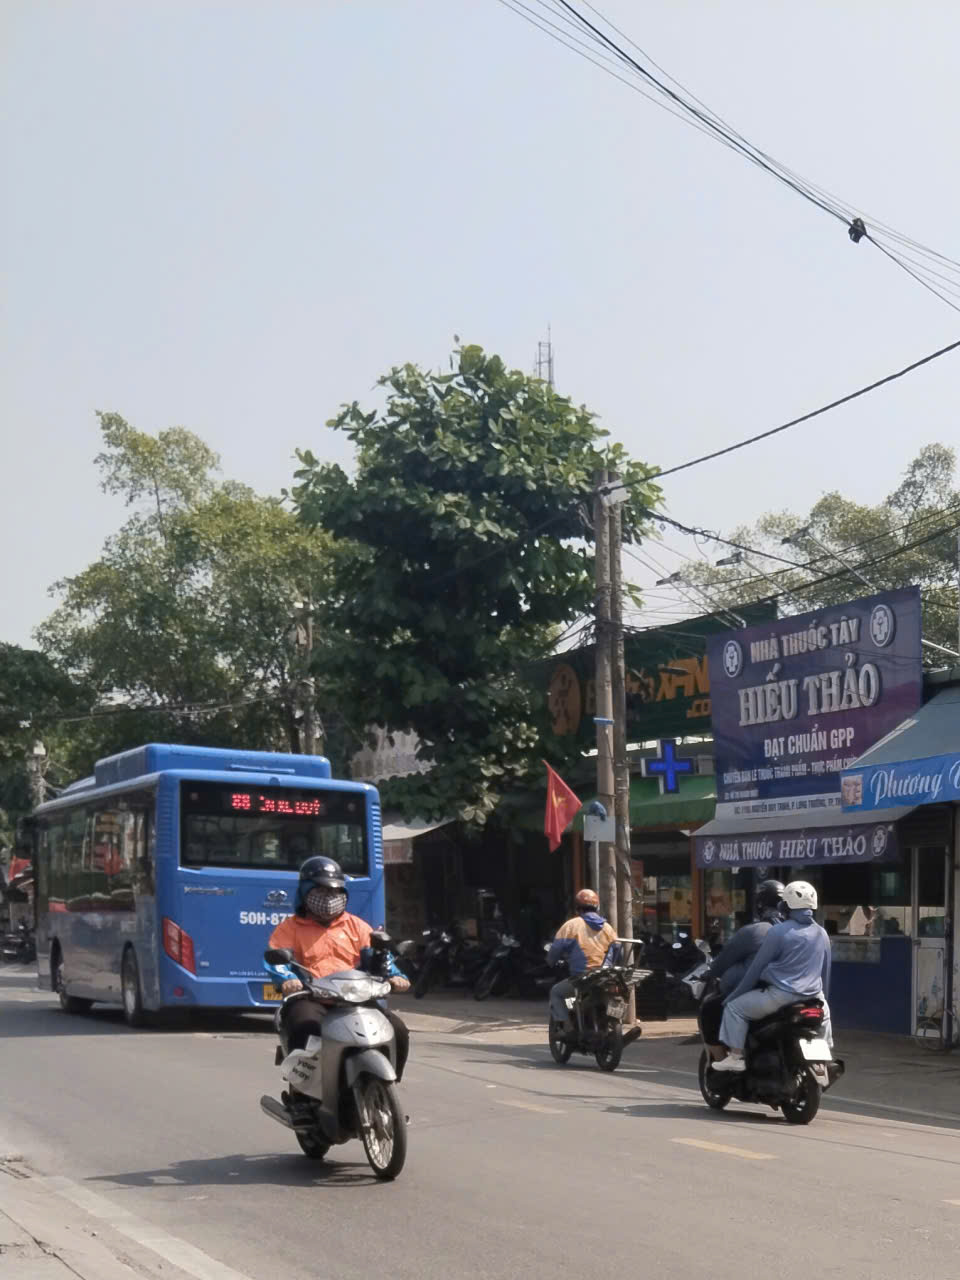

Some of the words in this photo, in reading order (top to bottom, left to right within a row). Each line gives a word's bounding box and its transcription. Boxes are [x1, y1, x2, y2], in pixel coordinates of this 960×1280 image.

[750, 633, 780, 664] NHÀ
[782, 618, 829, 657] THUỐC
[830, 615, 860, 647] TÂY
[738, 662, 799, 726] HIẾU
[802, 652, 880, 716] THẢO
[764, 736, 785, 761] ĐẠT
[787, 723, 828, 755] CHUẨN
[830, 726, 855, 749] GPP
[870, 768, 943, 806] Phương
[719, 839, 740, 861] NHÀ
[741, 835, 774, 860] THUỐC
